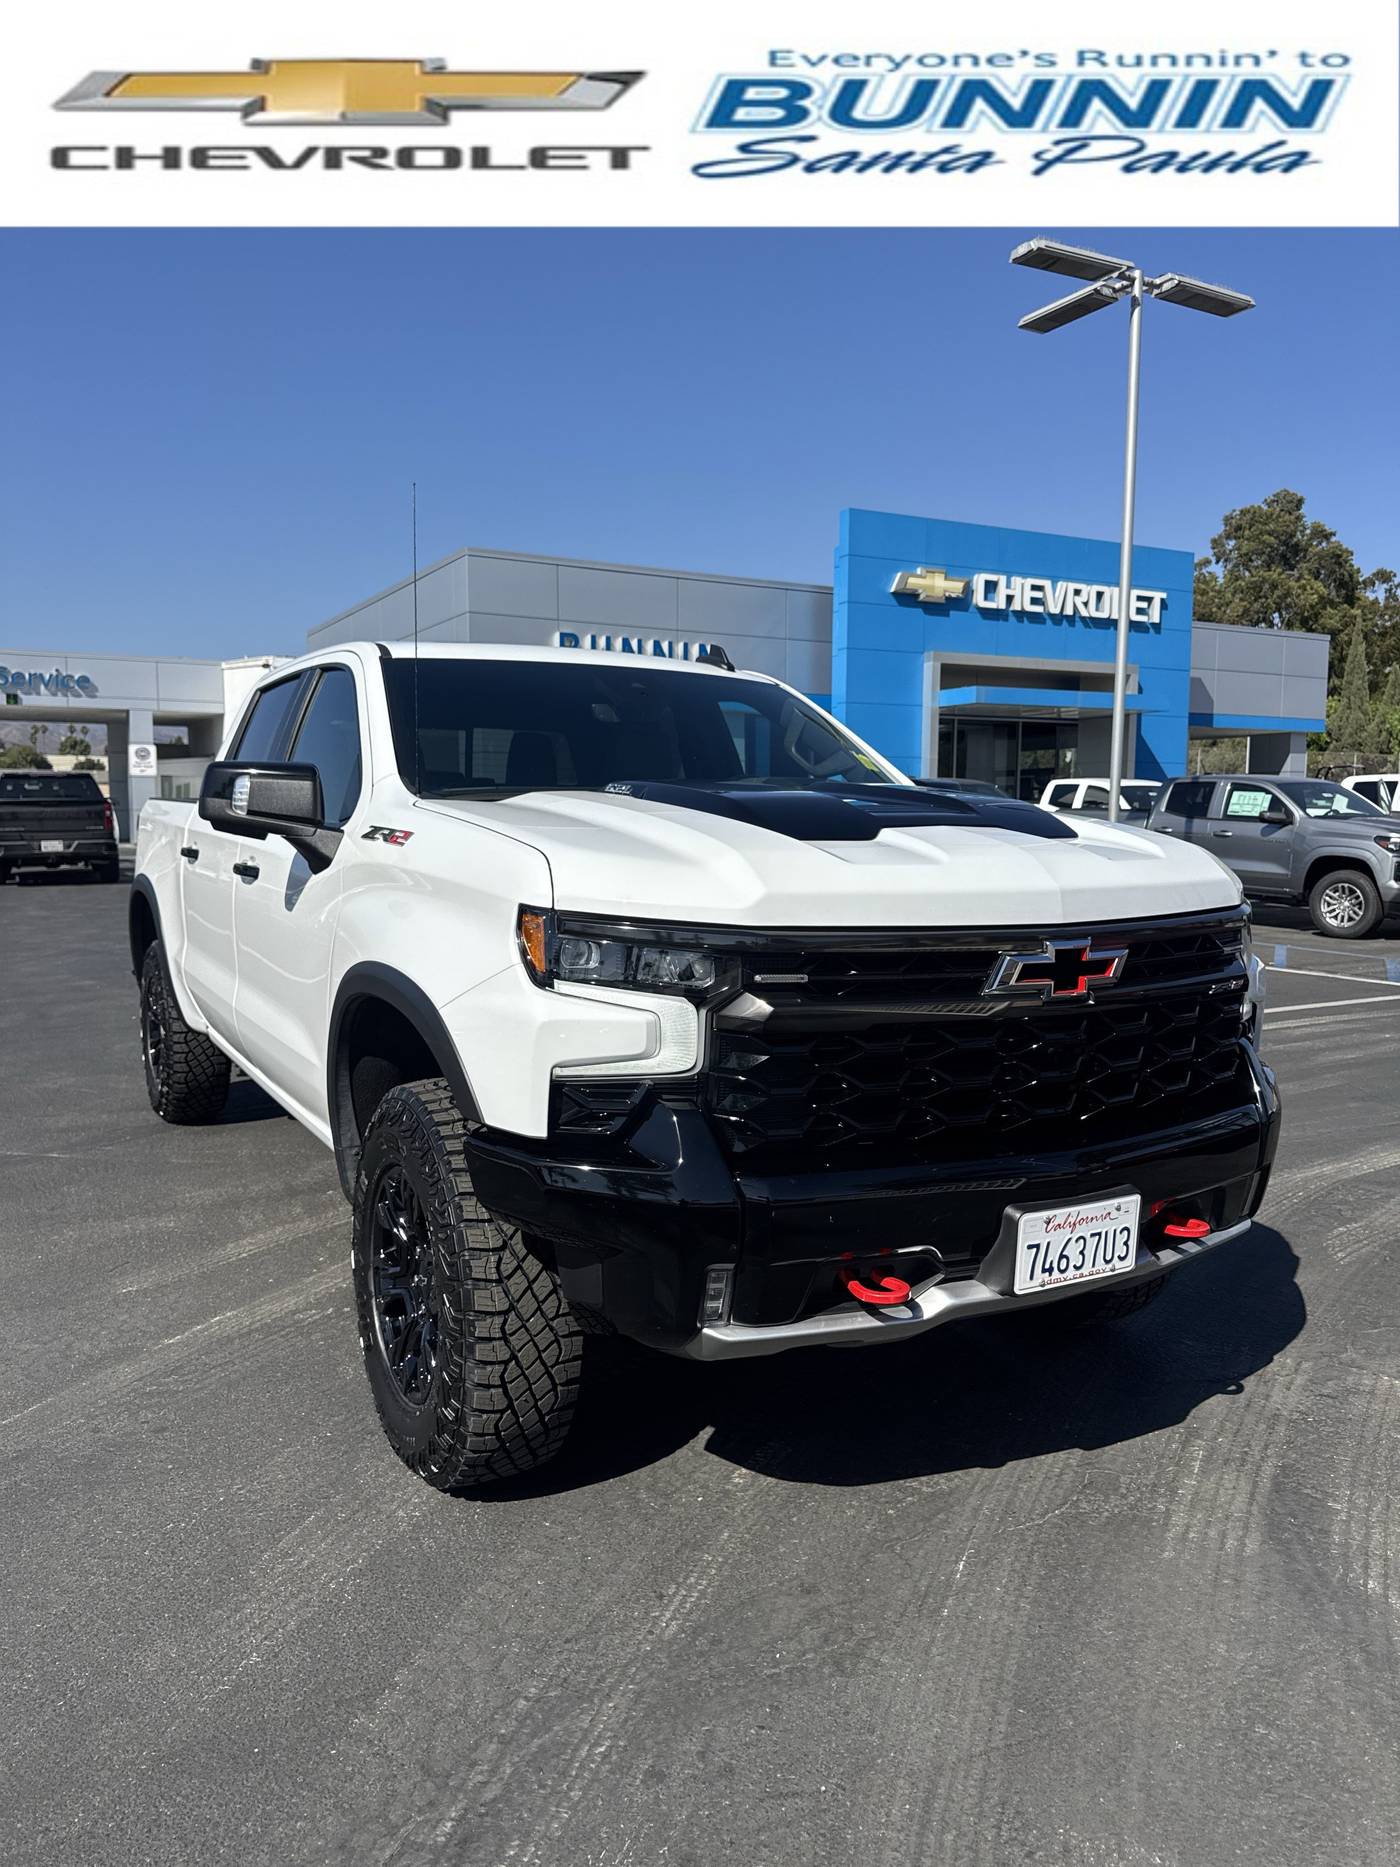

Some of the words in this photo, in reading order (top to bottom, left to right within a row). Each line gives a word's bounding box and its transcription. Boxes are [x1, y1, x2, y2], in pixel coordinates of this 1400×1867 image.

[0, 665, 92, 690] Service
[360, 824, 415, 847] ZR2
[1044, 1208, 1119, 1235] California
[1026, 1226, 1131, 1281] 74637U3
[1045, 1266, 1107, 1285] dmv.ca.gov
